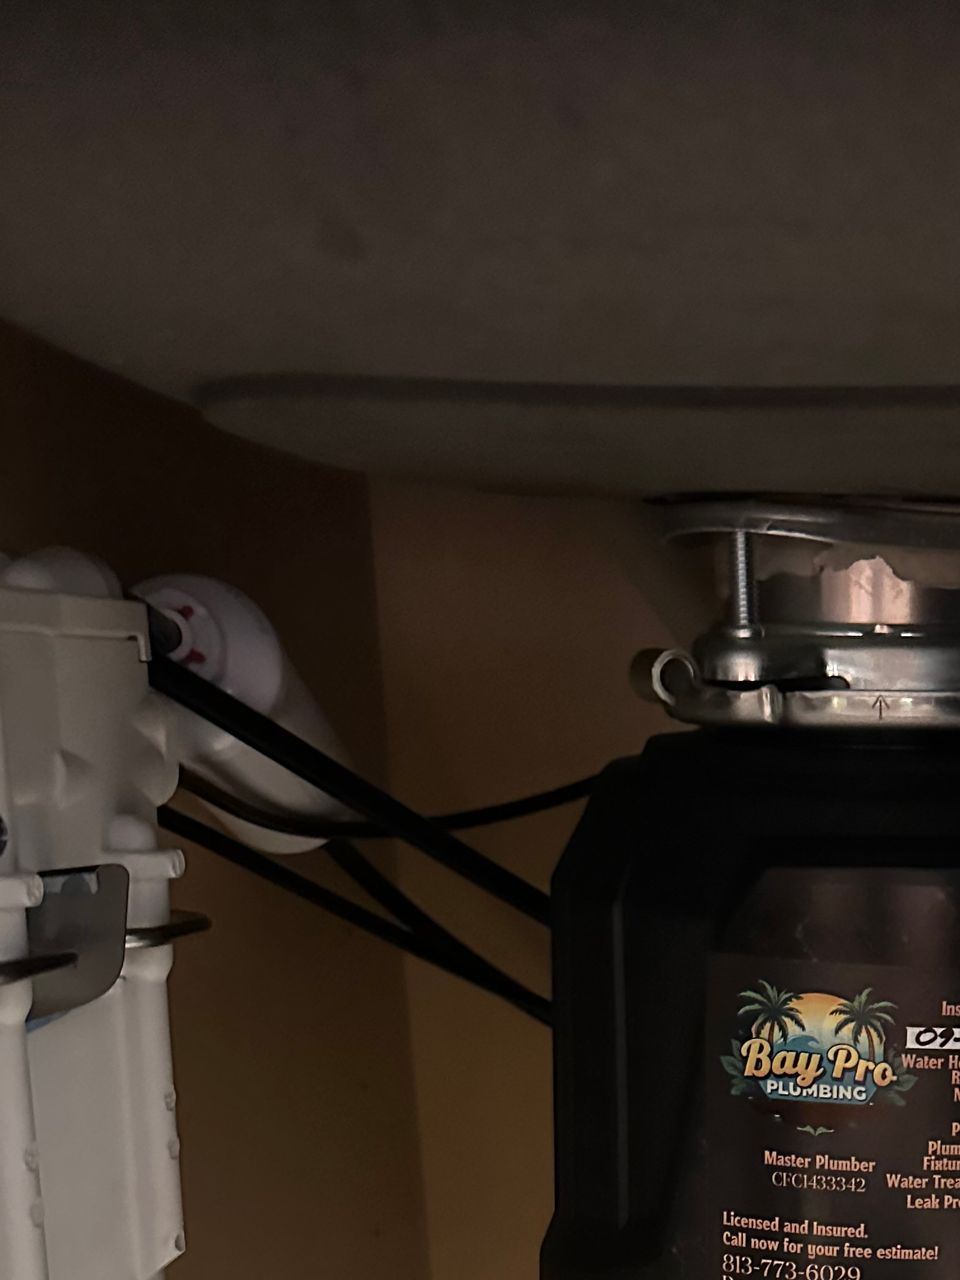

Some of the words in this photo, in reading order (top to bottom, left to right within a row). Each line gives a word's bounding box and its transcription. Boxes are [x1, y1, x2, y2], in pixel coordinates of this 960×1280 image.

[740, 1038, 824, 1087] Bay
[827, 1044, 898, 1087] Pro
[901, 1053, 944, 1070] Water
[766, 1079, 867, 1100] PLUMBING
[764, 1150, 812, 1168] Master
[815, 1154, 876, 1173] Plumber
[771, 1171, 867, 1193] CFC1433342
[886, 1173, 928, 1188] Water
[907, 1193, 940, 1209] Leak
[722, 1210, 780, 1232] Licensed
[783, 1219, 809, 1235] and
[813, 1220, 869, 1239] Insured.
[722, 1230, 747, 1248] Call
[750, 1237, 779, 1251] now
[783, 1237, 802, 1253] for
[807, 1245, 840, 1260] your
[844, 1242, 873, 1258] free
[876, 1244, 939, 1260] estimate!
